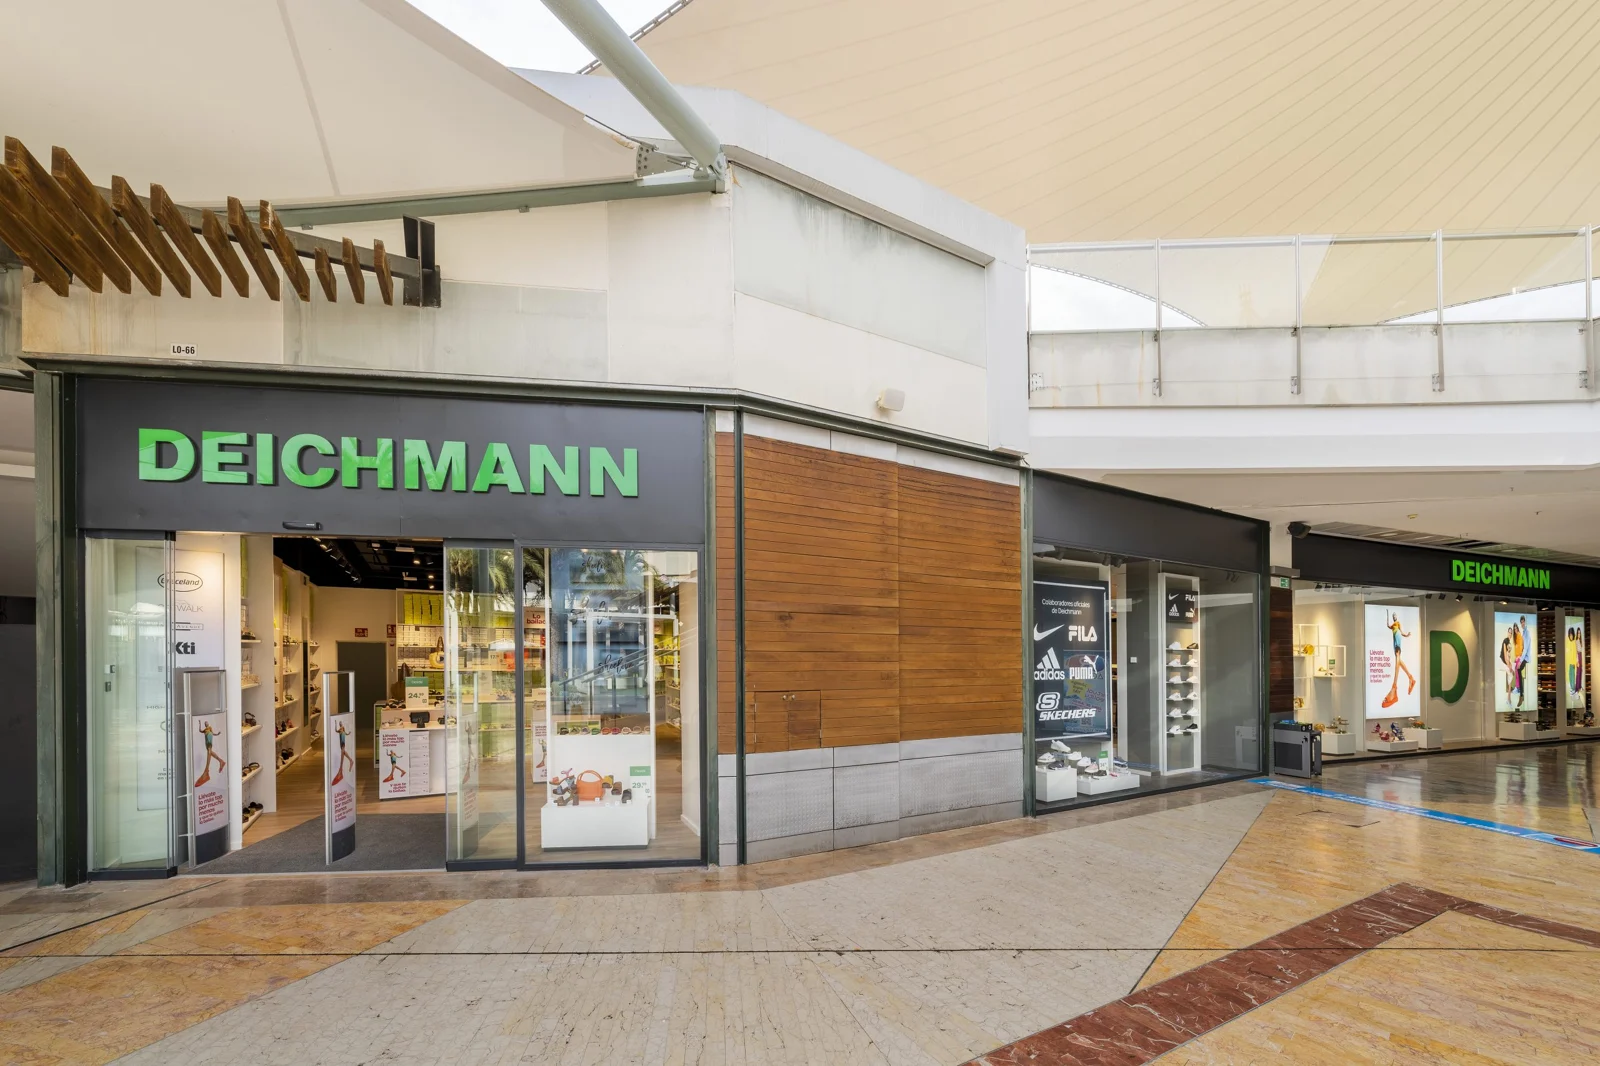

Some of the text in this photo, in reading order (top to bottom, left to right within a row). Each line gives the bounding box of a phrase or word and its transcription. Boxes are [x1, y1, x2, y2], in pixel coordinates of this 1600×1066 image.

[138, 428, 638, 497] DEICHMANN
[1452, 560, 1550, 589] DEICHMANN
[1042, 598, 1073, 607] Colaboradores
[1185, 594, 1196, 602] FILA
[1068, 625, 1098, 642] FILA
[1034, 668, 1066, 680] adidas
[1069, 666, 1094, 680] PUMA
[1039, 708, 1096, 721] SKECHERS
[208, 800, 223, 808] mucho
[215, 794, 223, 802] top
[199, 808, 216, 816] menos
